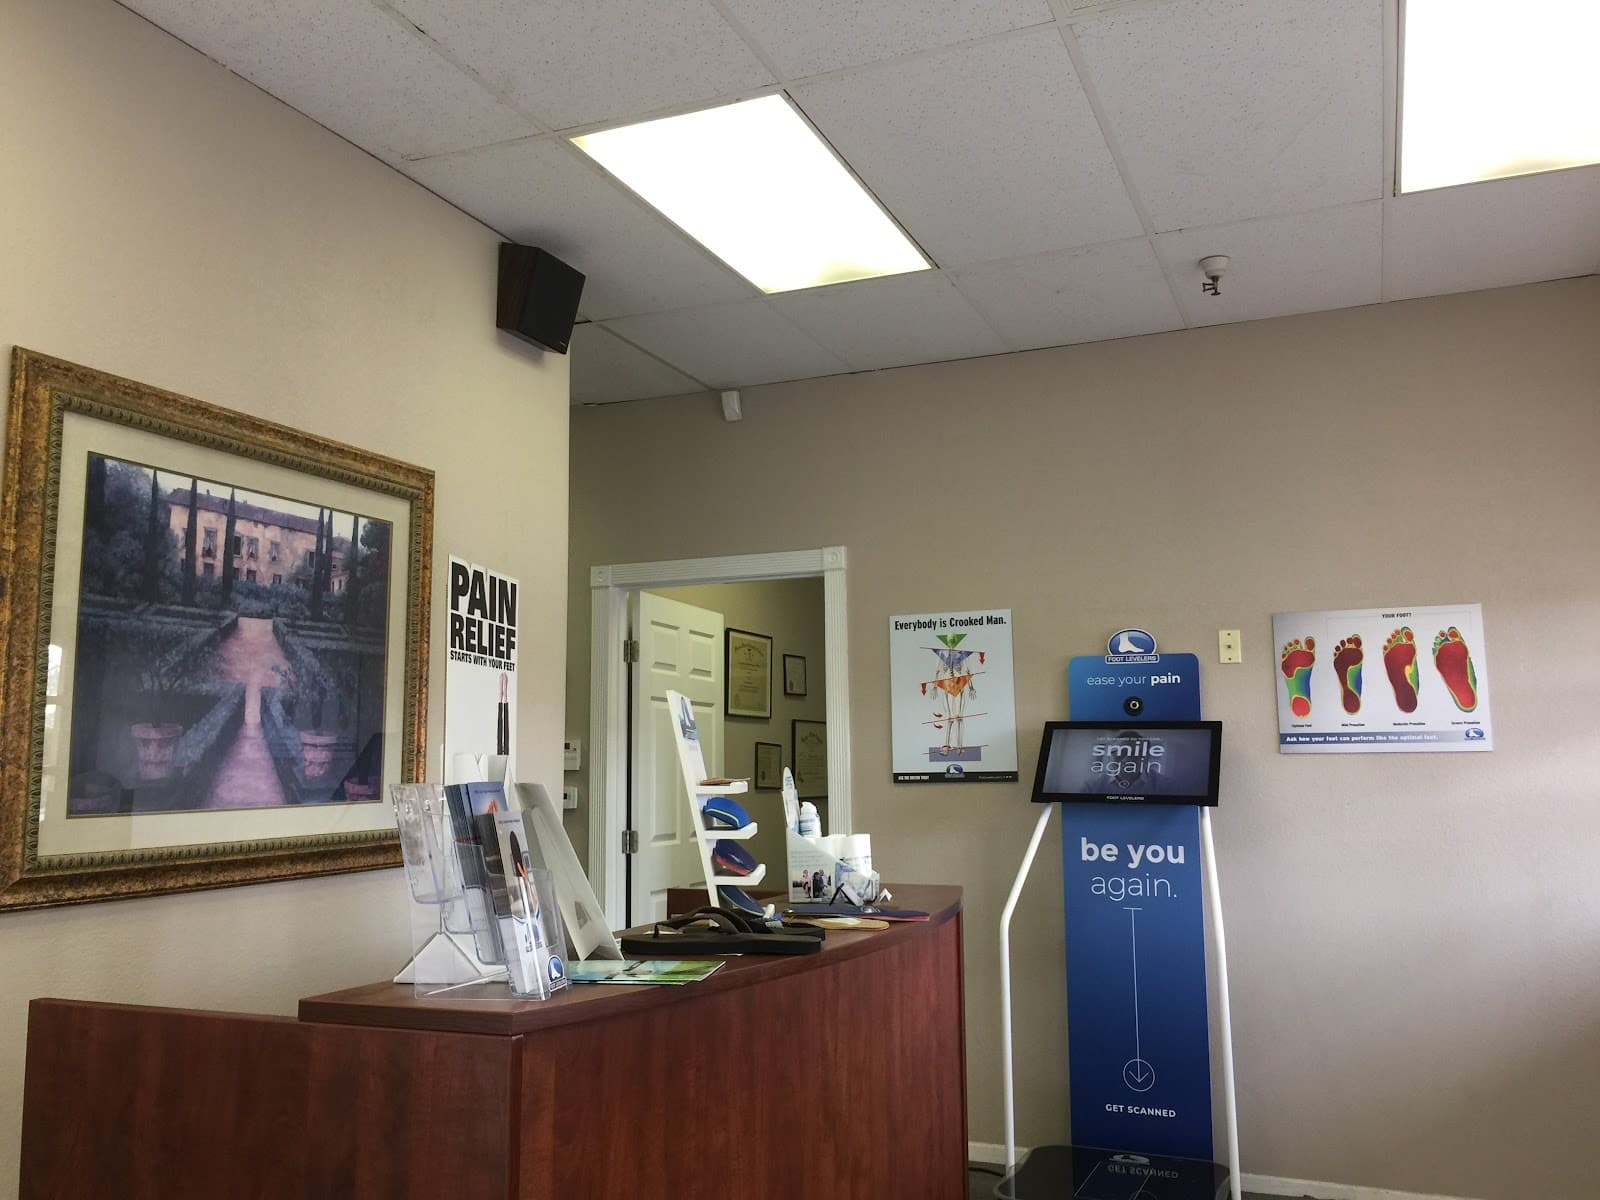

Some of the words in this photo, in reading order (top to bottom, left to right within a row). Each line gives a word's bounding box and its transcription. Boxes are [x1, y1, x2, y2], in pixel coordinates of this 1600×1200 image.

[451, 562, 517, 626] PAIN
[895, 619, 937, 631] Everybody
[940, 618, 947, 628] is
[949, 616, 983, 627] Crooked
[986, 615, 1006, 625] Man.
[450, 612, 516, 660] RELIEF
[450, 650, 472, 664] STARTS
[473, 654, 488, 667] WITH
[488, 658, 503, 670] YOUR
[503, 661, 515, 672] FEET
[1087, 676, 1115, 686] ease
[1118, 676, 1146, 687] your
[1151, 672, 1181, 686] pain
[1400, 734, 1423, 742] optimal
[1092, 741, 1165, 757] smile
[1090, 758, 1161, 777] again
[1081, 837, 1119, 862] be
[1127, 844, 1185, 869] you
[1091, 873, 1177, 901] again.
[1105, 1103, 1125, 1113] GET
[1127, 1105, 1177, 1118] SCANNED
